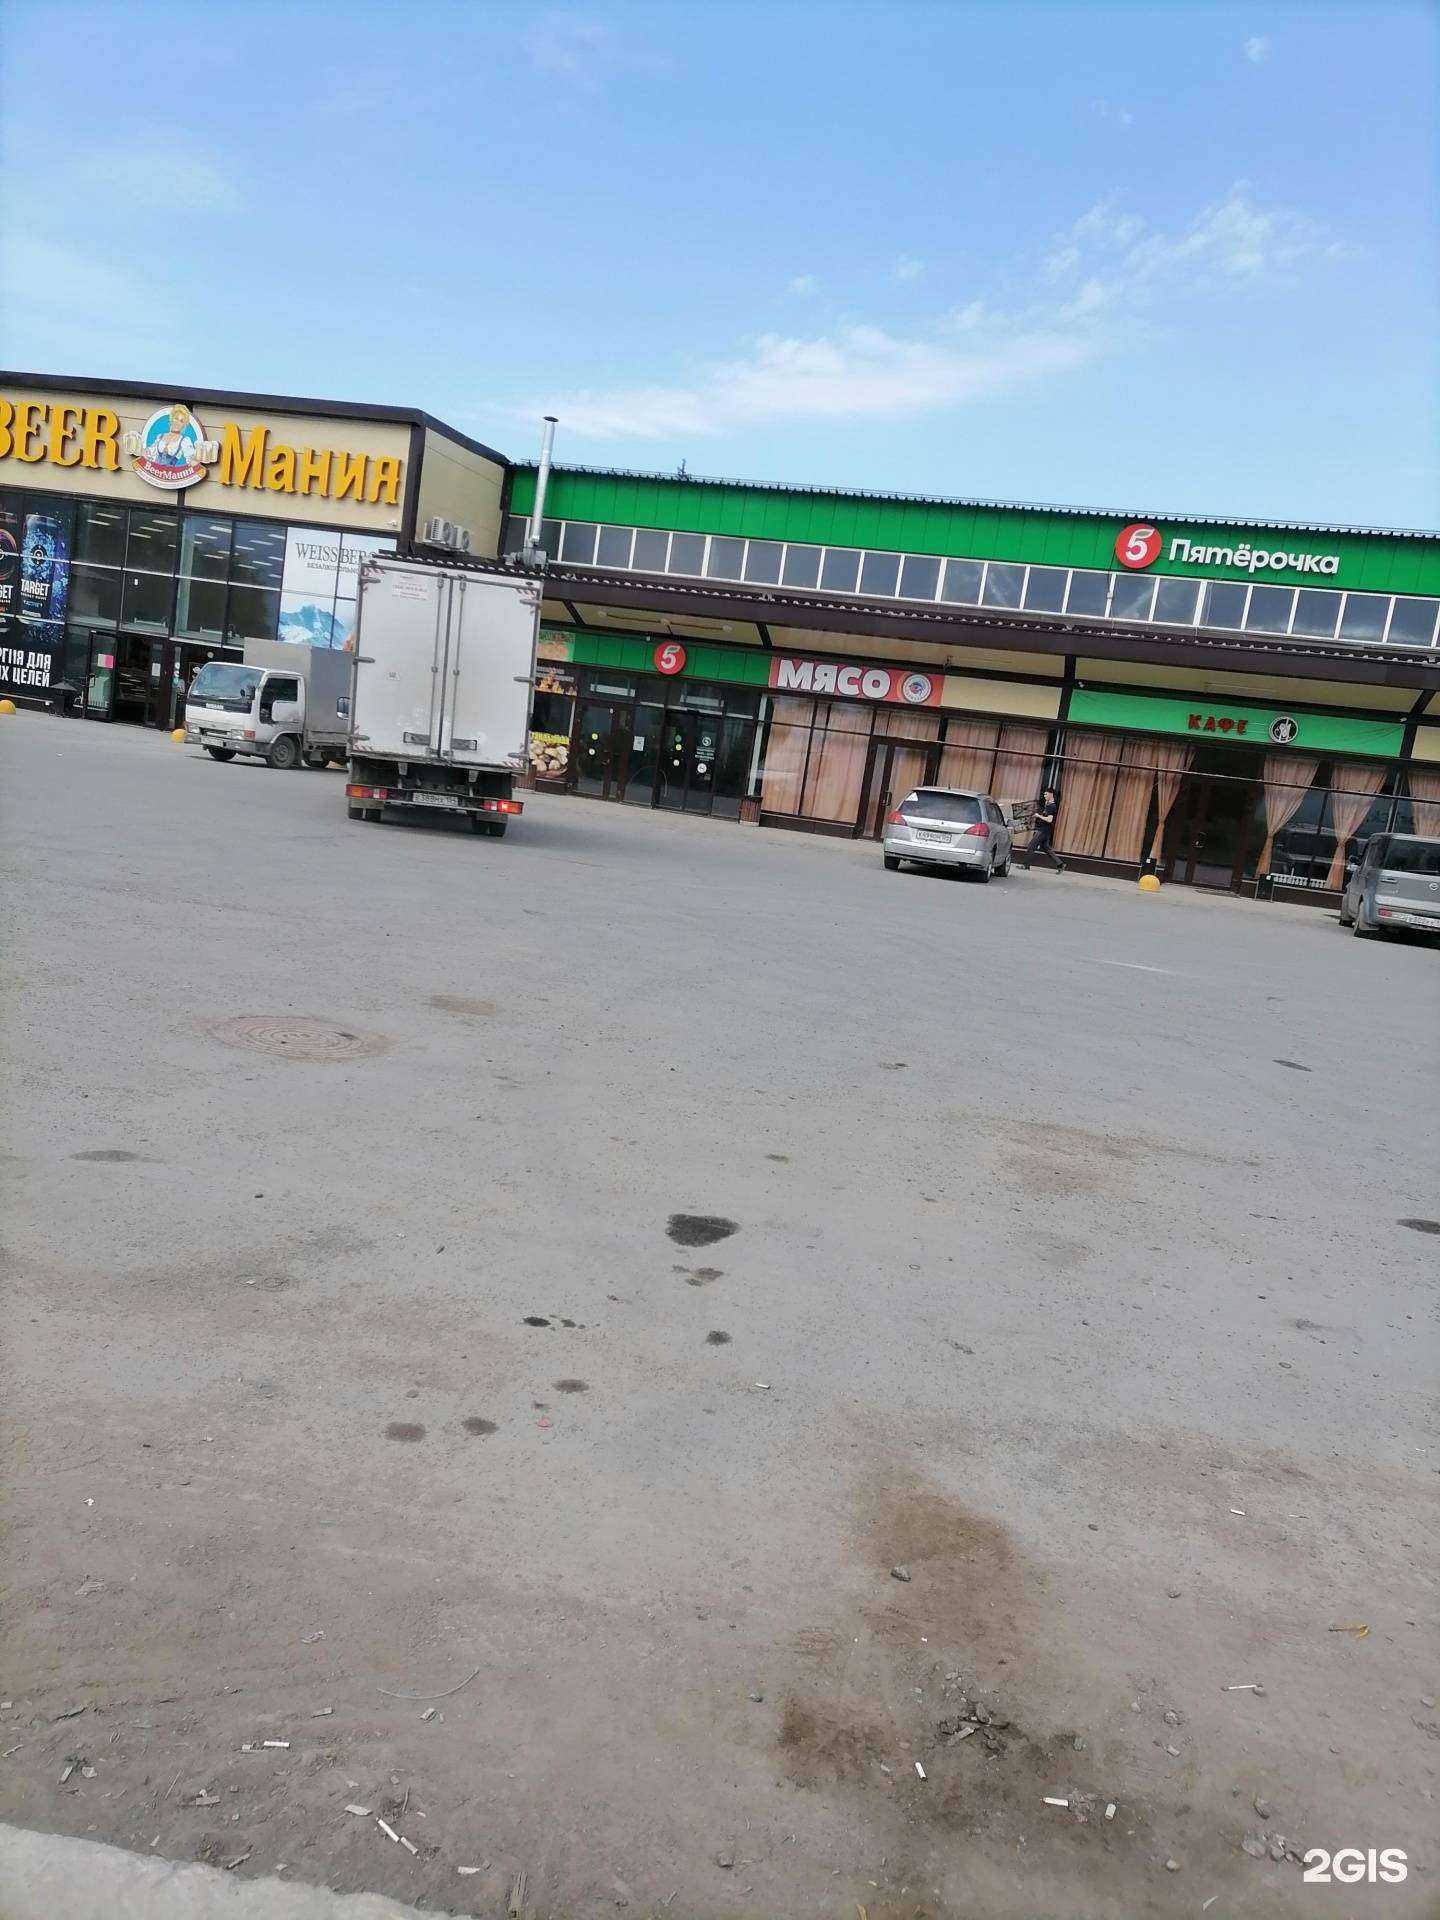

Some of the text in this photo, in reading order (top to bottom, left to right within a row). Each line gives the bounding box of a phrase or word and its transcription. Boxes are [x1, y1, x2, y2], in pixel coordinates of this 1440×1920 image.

[220, 421, 402, 505] Мания
[1125, 528, 1155, 561] 5
[1168, 537, 1340, 574] Пятёрочка
[21, 579, 50, 597] TARGET
[27, 651, 51, 670] ДЛЯ
[660, 645, 680, 669] 5
[13, 667, 50, 687] ЦЕЛЕЙ
[777, 659, 891, 699] МЯСО
[1187, 714, 1248, 735] КАФЕ
